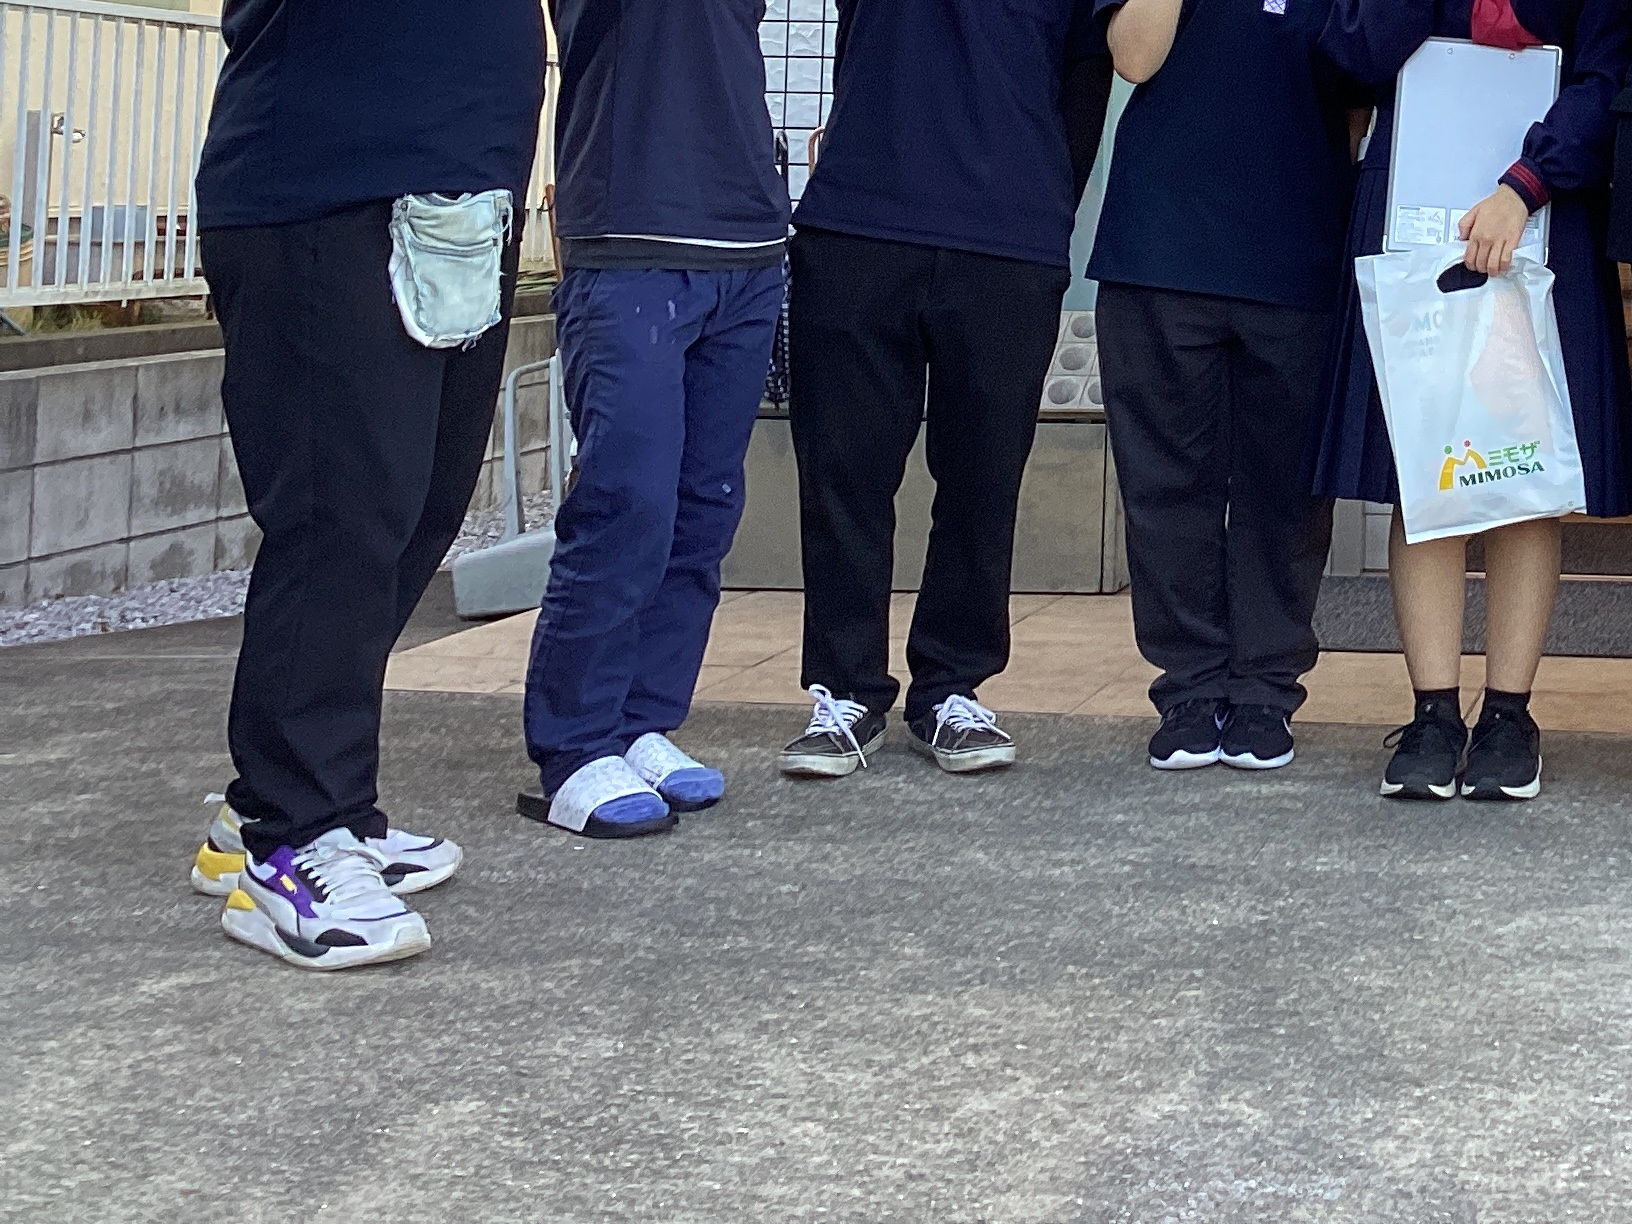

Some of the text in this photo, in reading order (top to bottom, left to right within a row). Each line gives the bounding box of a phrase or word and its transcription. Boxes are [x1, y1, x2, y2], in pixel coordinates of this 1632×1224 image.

[1487, 440, 1541, 466] ミモザ
[1459, 460, 1545, 487] MIMOSA
